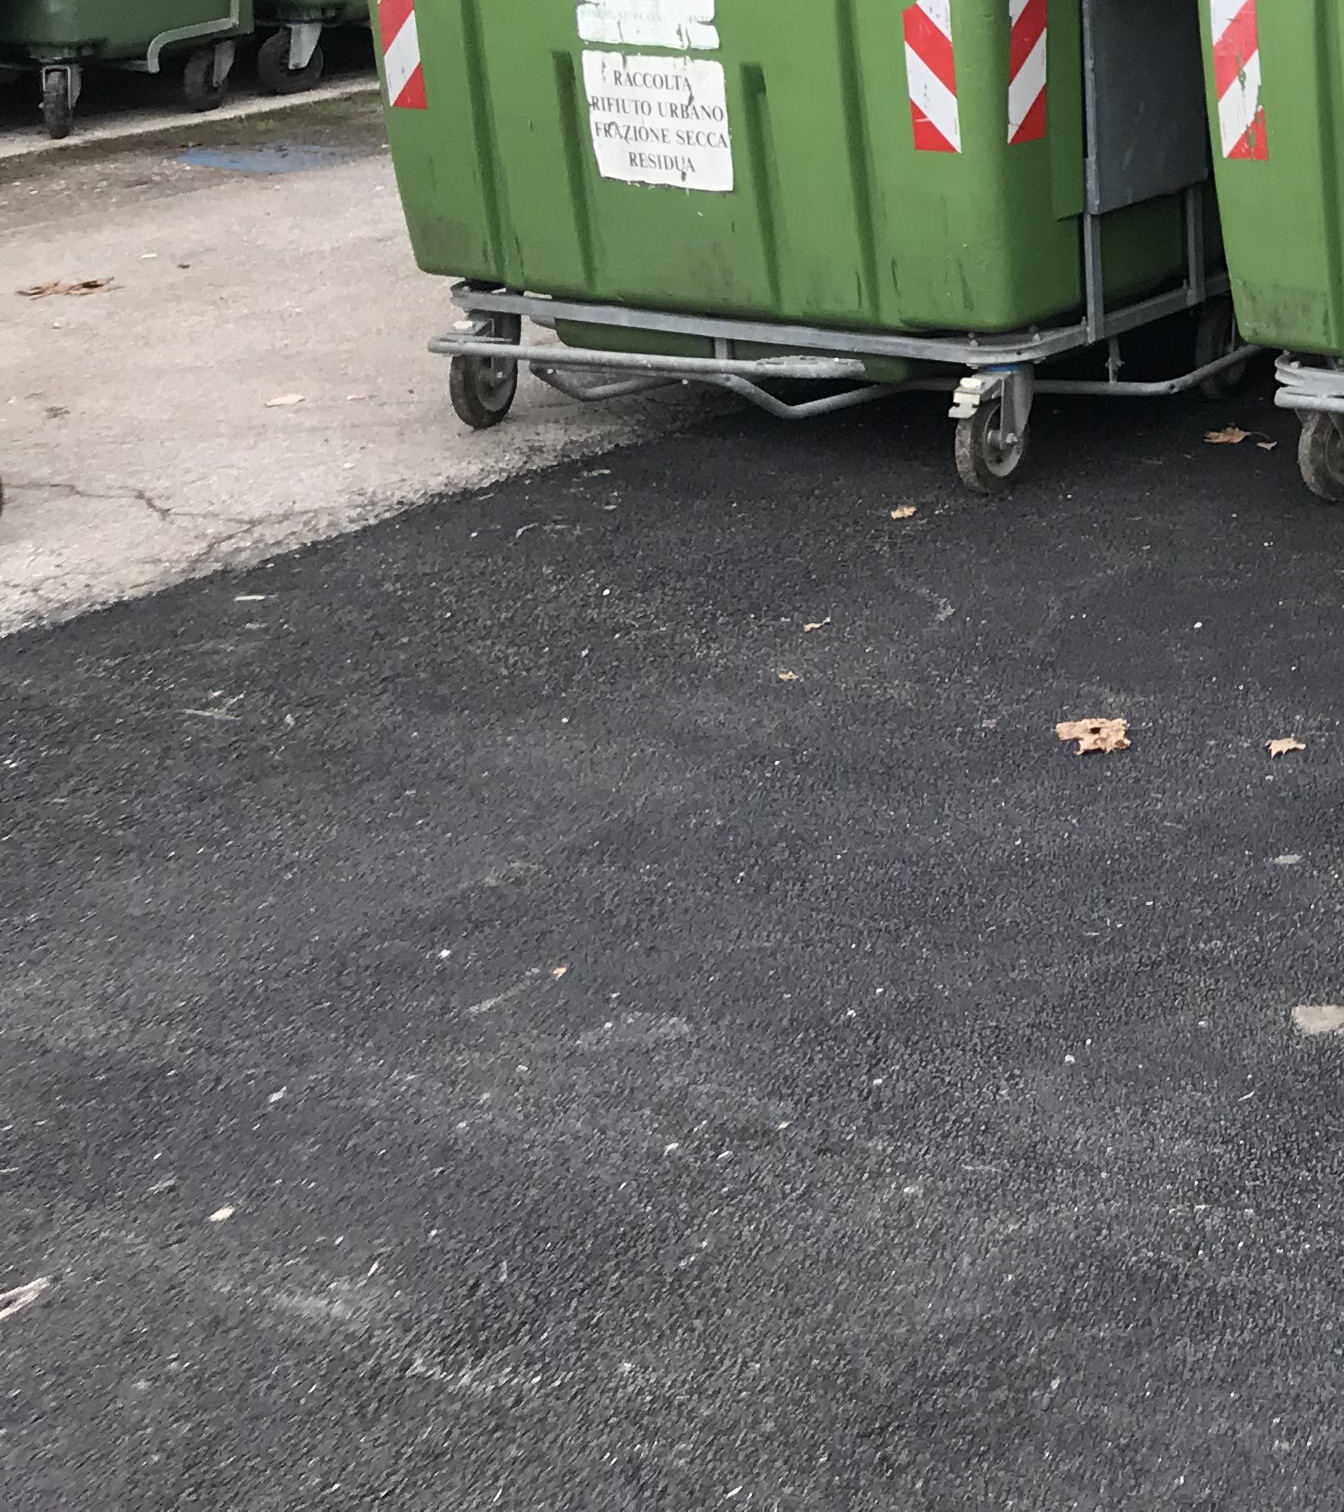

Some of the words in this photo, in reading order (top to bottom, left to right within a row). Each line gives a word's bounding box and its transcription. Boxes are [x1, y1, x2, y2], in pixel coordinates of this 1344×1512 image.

[614, 70, 691, 92] RACCOLTA
[591, 96, 651, 116] RIFIUTO
[658, 102, 724, 122] URBANO
[595, 121, 670, 144] FRAZIONE
[676, 130, 728, 148] SECCA
[629, 152, 695, 172] RESIDUA
